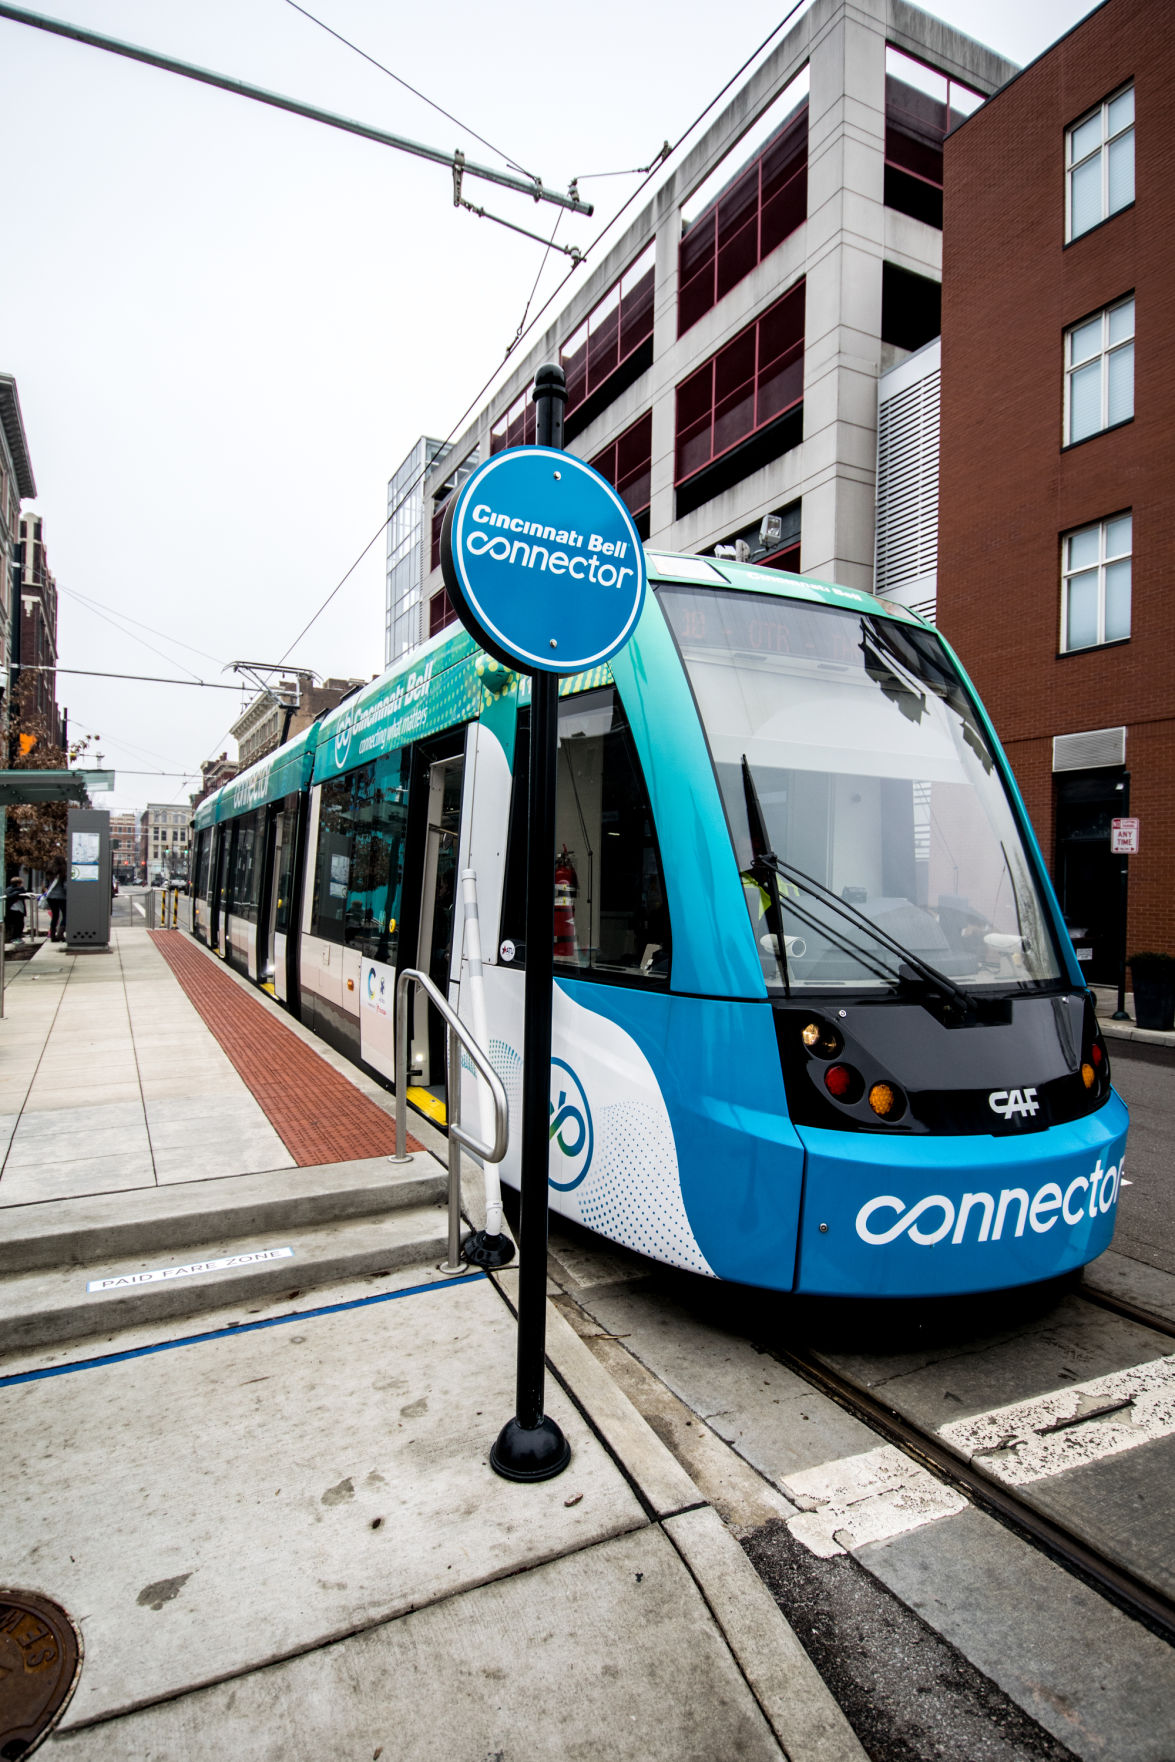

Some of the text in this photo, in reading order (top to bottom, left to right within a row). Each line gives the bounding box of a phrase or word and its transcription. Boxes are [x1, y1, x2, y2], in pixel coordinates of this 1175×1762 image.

[472, 504, 627, 558] Cincinnati Bell
[466, 531, 634, 588] connector
[353, 660, 433, 735] Cincinnati Bell
[988, 1087, 1040, 1119] CAF
[102, 1250, 281, 1288] PAID FARE ZONE
